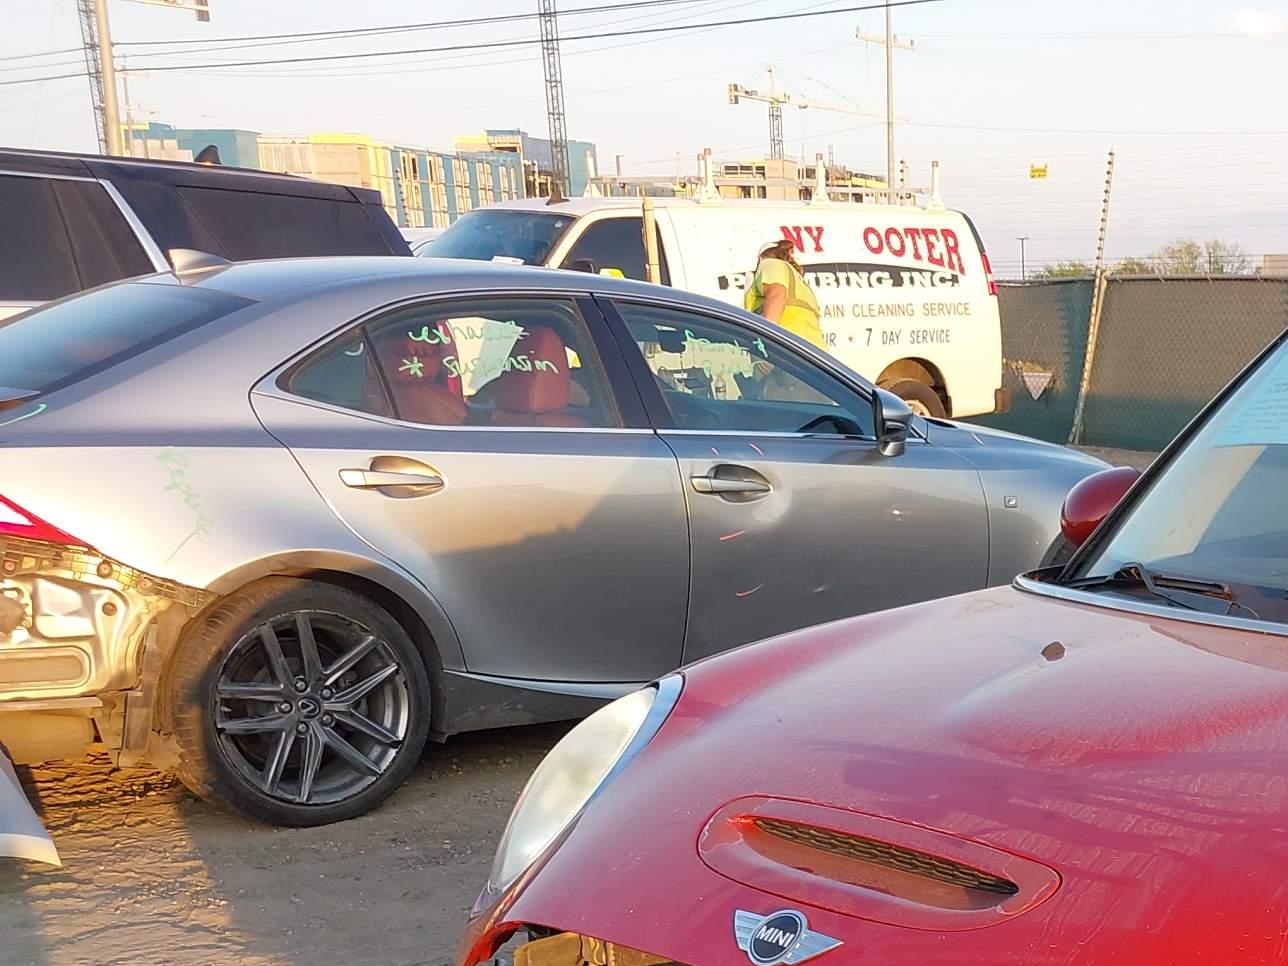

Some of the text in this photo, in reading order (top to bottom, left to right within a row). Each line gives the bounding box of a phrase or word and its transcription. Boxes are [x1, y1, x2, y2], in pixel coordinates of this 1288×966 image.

[863, 227, 965, 275] OOTER
[852, 303, 915, 318] CLEANING
[922, 302, 971, 317] SERVICE
[821, 328, 951, 347] IR 7 DAY SERVICE
[755, 925, 795, 948] MINI
